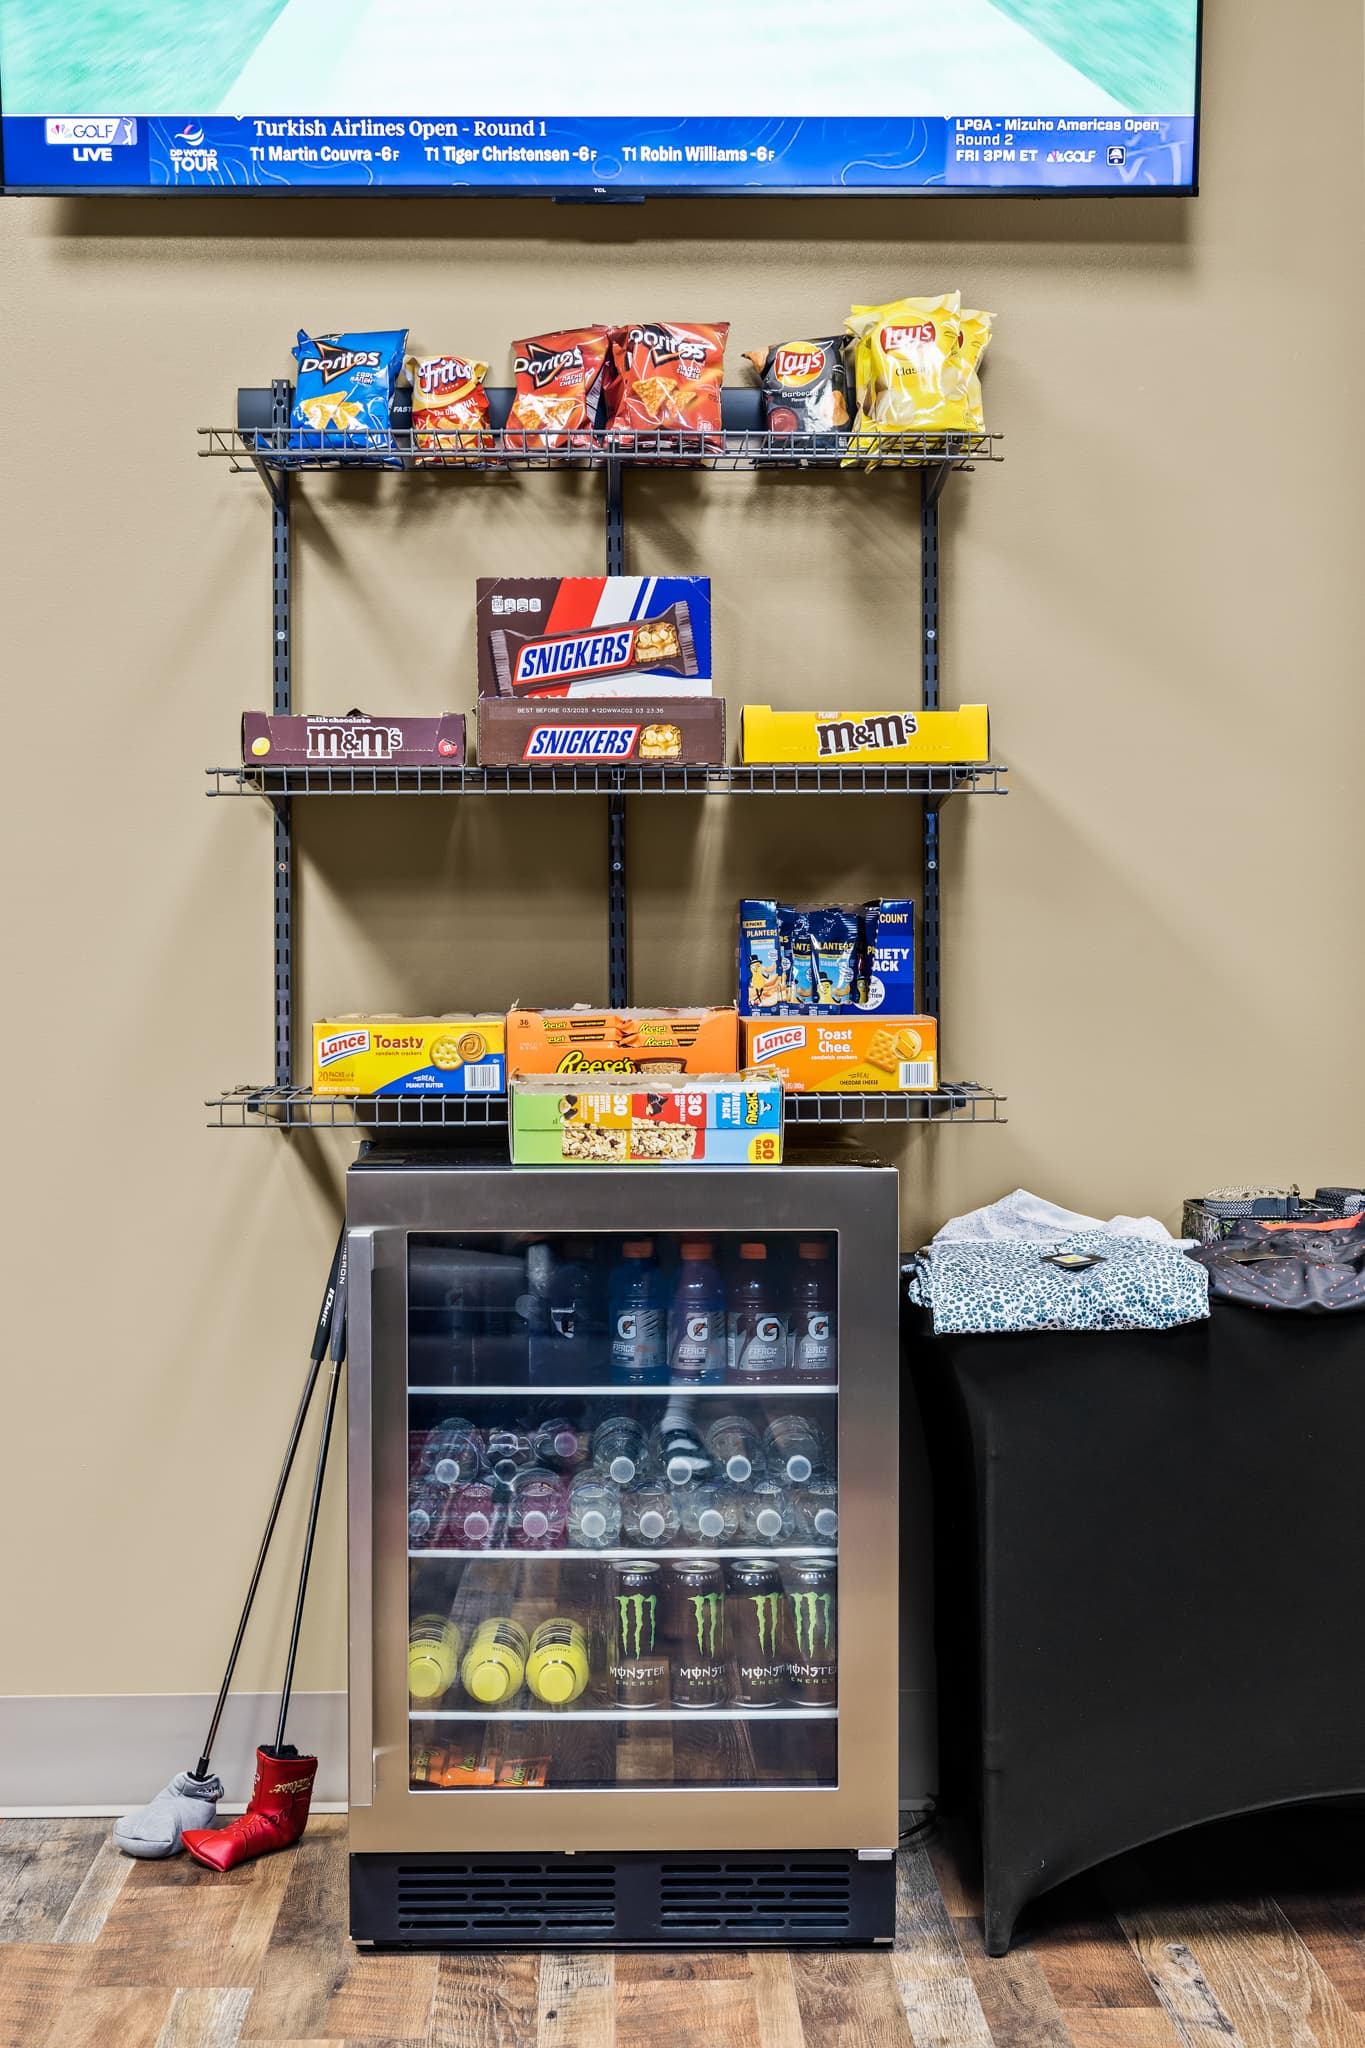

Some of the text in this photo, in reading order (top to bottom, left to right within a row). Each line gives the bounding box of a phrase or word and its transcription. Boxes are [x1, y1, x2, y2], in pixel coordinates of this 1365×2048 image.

[73, 124, 113, 139] GOLF
[253, 120, 328, 137] Turkish
[330, 120, 405, 137] Airlines
[409, 121, 458, 138] Open
[474, 120, 536, 137] Round
[540, 121, 547, 137] 1
[955, 118, 993, 131] LPGA
[1004, 118, 1055, 132] Mizuho
[1056, 119, 1122, 132] Americas
[1124, 119, 1160, 132] Open
[955, 133, 1014, 146] Round 2
[72, 147, 113, 162] LIVE
[169, 149, 217, 157] DP WORLD
[250, 147, 265, 161] T1
[268, 146, 318, 162] Martin
[320, 146, 373, 162] Couvra
[424, 147, 440, 161] T1
[442, 146, 480, 164] Tiger
[481, 146, 571, 162] Christensen
[622, 146, 638, 161] T1
[640, 146, 683, 162] Robin
[684, 146, 748, 162] Williams
[955, 149, 1039, 162] FRI 3PM ET
[1063, 150, 1096, 163] GOLF
[172, 157, 219, 173] TOUR
[630, 329, 708, 361] Doritos
[301, 351, 381, 374] Doritos
[514, 347, 584, 374] Doritos
[776, 352, 823, 375] Lay's
[559, 378, 583, 387] CHEESE
[561, 372, 583, 382] NACHO
[520, 633, 630, 678] SNICKERS
[530, 729, 633, 754] SNICKERS
[879, 913, 909, 924] COUNT
[874, 948, 910, 960] RIETY
[872, 960, 899, 972] ACK
[373, 1034, 424, 1049] Toasty
[816, 1027, 853, 1040] Toast
[321, 1034, 367, 1058] Lance
[756, 1030, 803, 1054] Lance
[817, 1041, 850, 1053] Chee
[555, 1050, 635, 1074] Reese's
[318, 1071, 329, 1082] 20
[613, 1094, 628, 1116] 30
[688, 1094, 702, 1116] 30
[721, 1097, 731, 1119] PACK
[762, 1139, 775, 1160] 60
[320, 1288, 335, 1327] IOMIC
[617, 1315, 637, 1340] G
[686, 1317, 708, 1342] G
[679, 1346, 708, 1355] FIERCE
[609, 1665, 664, 1680] MONSTER
